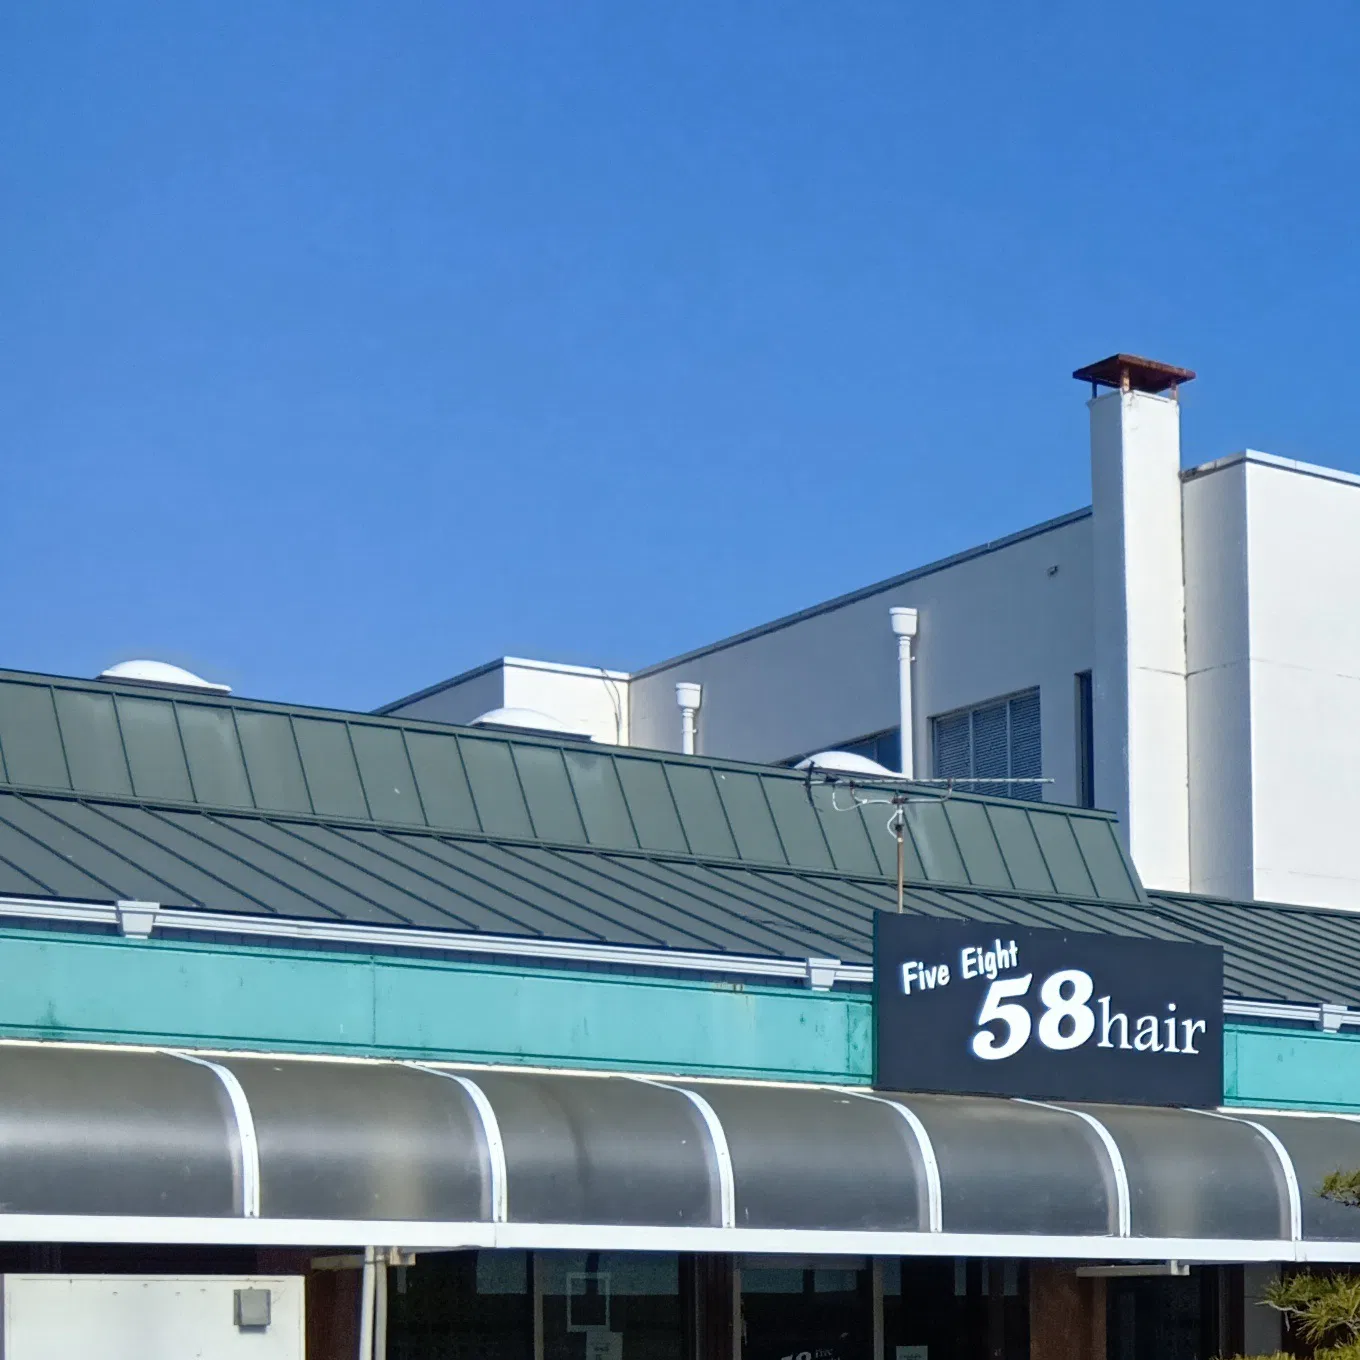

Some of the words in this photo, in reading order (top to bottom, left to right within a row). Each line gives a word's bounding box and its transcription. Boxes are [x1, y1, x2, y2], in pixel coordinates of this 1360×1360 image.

[902, 961, 951, 995] Five
[961, 939, 1019, 980] Eight
[972, 969, 1096, 1060] 58
[1097, 995, 1206, 1055] hair
